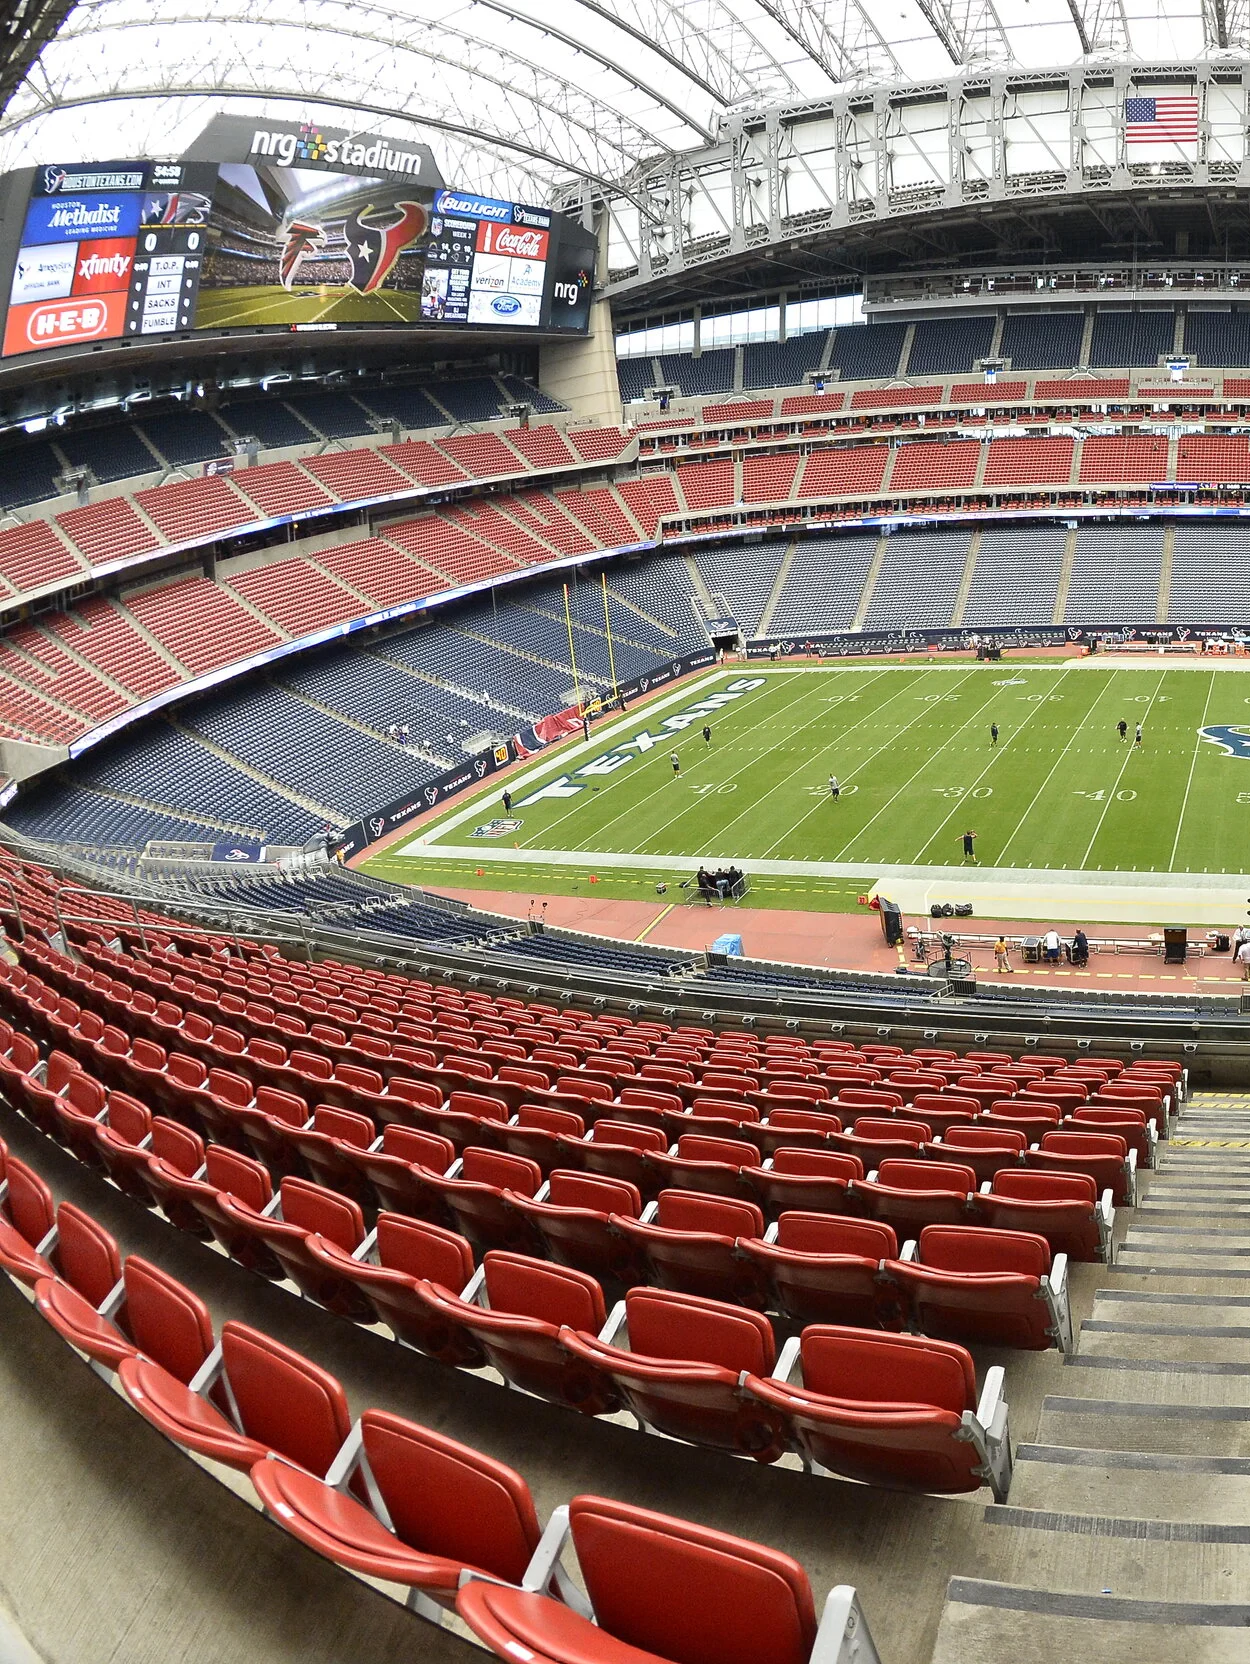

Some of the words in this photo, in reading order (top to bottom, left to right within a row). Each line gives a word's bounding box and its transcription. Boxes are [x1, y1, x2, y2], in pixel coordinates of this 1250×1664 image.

[251, 130, 298, 167] nrg
[324, 137, 422, 175] stadium
[61, 173, 143, 190] HOUSTONTEXANS.COM
[443, 197, 472, 214] BUD
[471, 202, 510, 218] LIGHT
[48, 203, 121, 228] Methodist
[91, 226, 118, 234] MEDICINE
[452, 231, 467, 239] WEEK
[145, 233, 157, 251] 0
[188, 232, 200, 250] 0
[79, 252, 131, 280] xfinity
[155, 261, 179, 270] T.O.P.
[157, 280, 172, 289] INT
[475, 276, 504, 288] verizon
[511, 276, 541, 288] Academy
[554, 282, 578, 306] nrg
[147, 298, 176, 309] SACKS
[143, 317, 175, 328] FUMBLE
[690, 655, 714, 666] TEXANS
[651, 672, 670, 684] TEXANS
[511, 677, 768, 808] TEXANS
[495, 748, 507, 762] 40
[443, 773, 472, 792] TEXANS
[1084, 790, 1138, 802] 40
[390, 801, 422, 822] TEXANS
